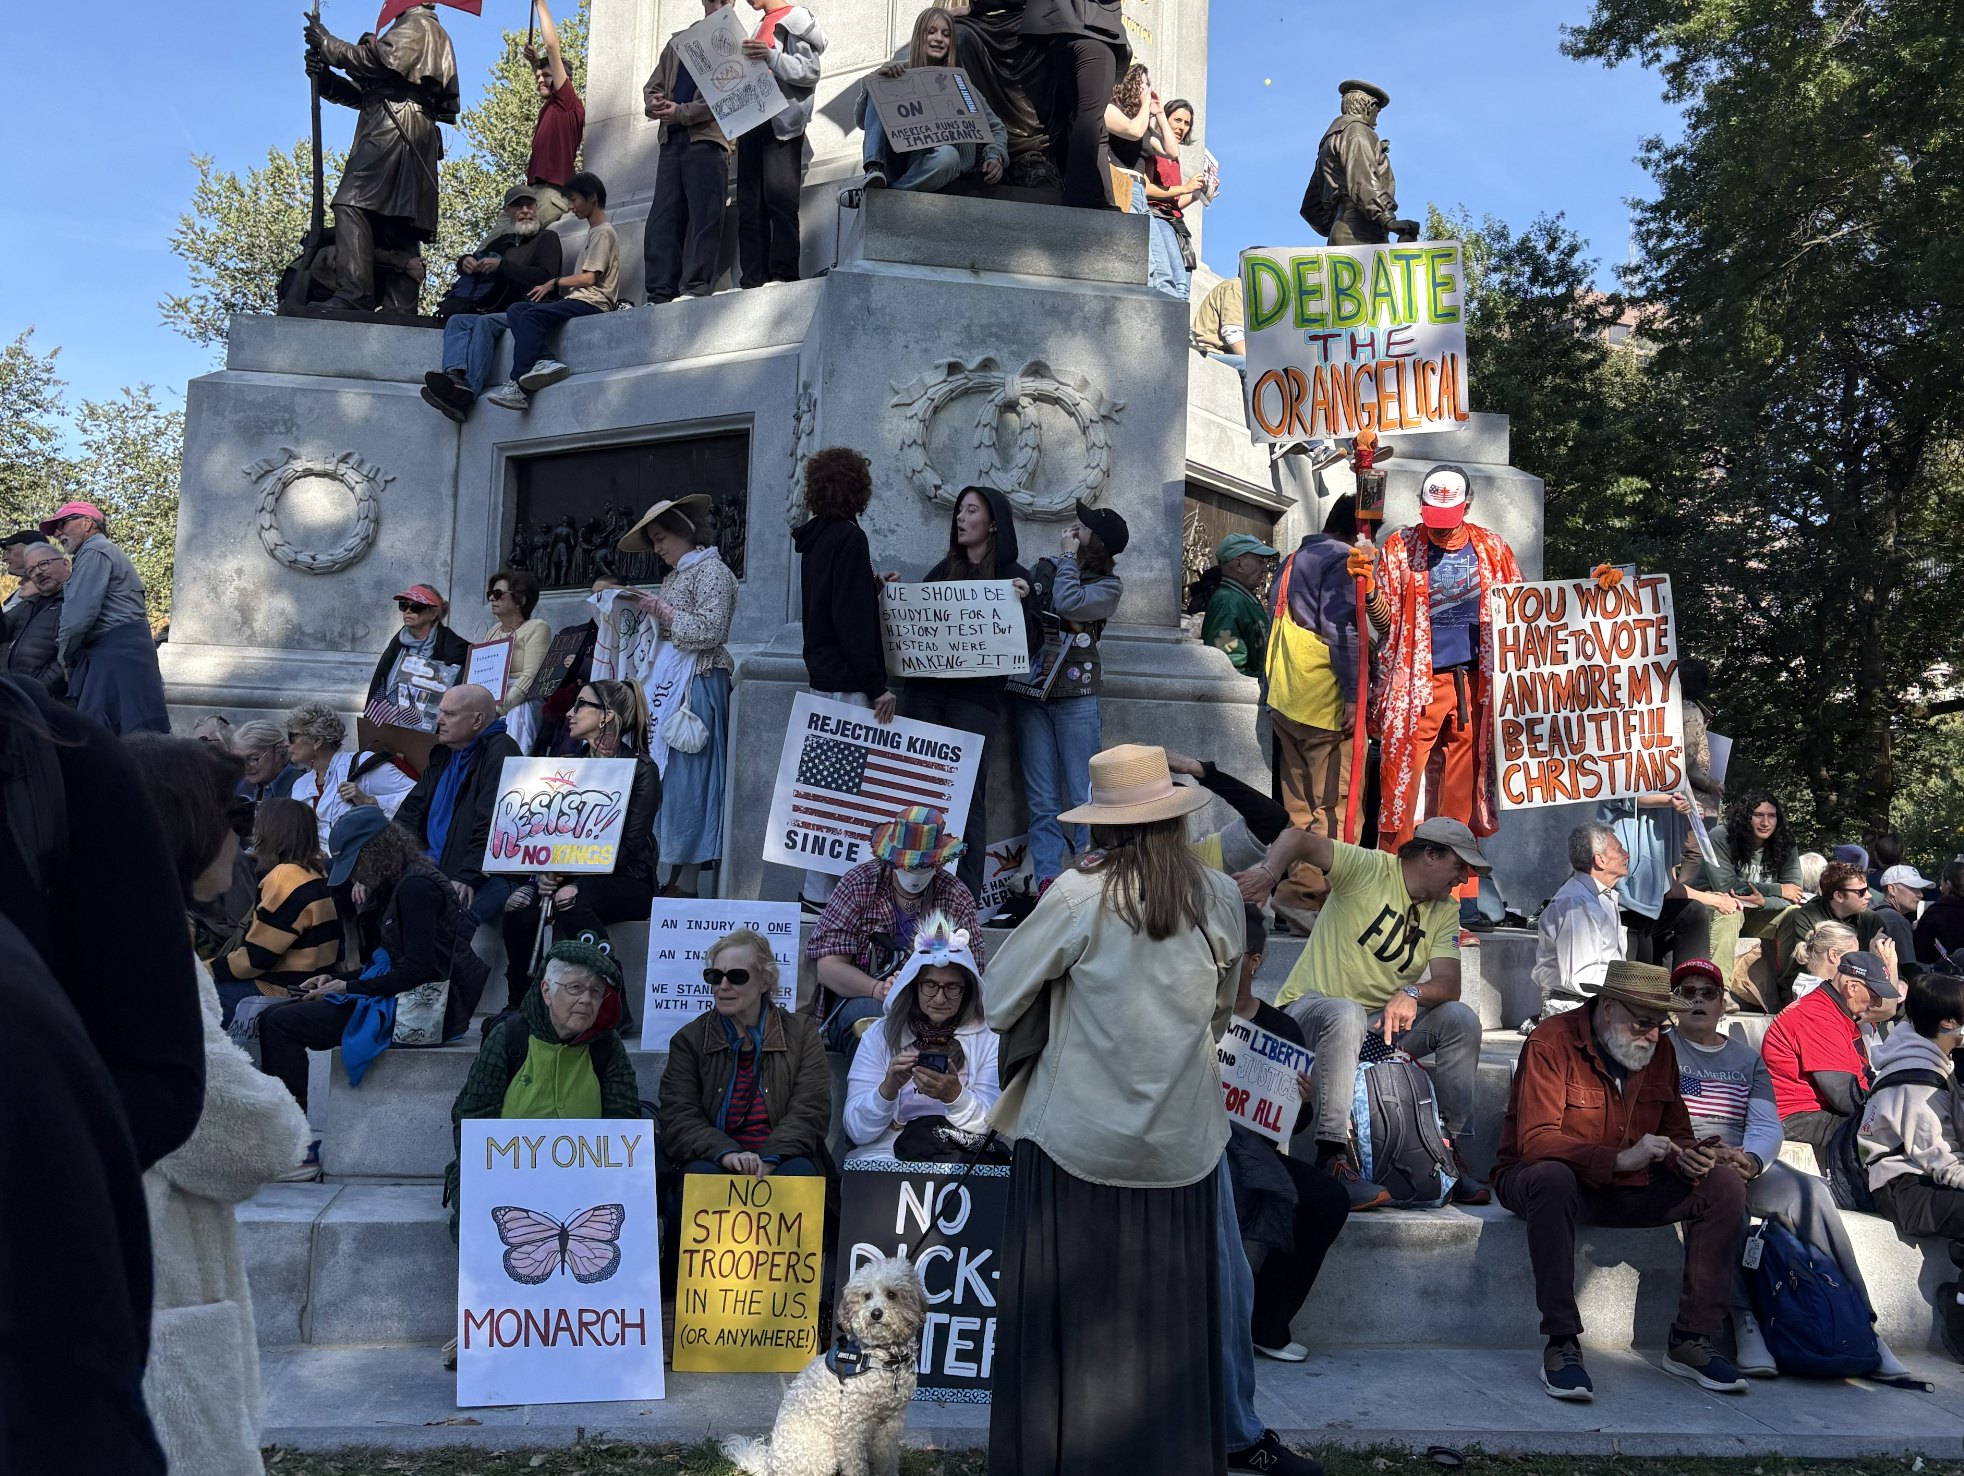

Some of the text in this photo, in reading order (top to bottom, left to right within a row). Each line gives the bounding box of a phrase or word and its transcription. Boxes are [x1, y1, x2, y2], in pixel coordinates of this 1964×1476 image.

[896, 100, 924, 118] ON
[891, 120, 976, 140] AMERICA RUNS ON
[903, 129, 984, 148] IMMIGRANTS
[1243, 247, 1460, 332] DEBATE
[1304, 324, 1419, 367] THE
[1252, 351, 1469, 438] ORANGELICAL
[886, 586, 1007, 601] WE SHOULD BE
[882, 607, 1002, 622] STUDYING FOR A
[885, 624, 939, 638] HISTORY
[945, 624, 988, 636] TEST
[887, 640, 988, 651] INSTEAD WE'RE
[1498, 616, 1669, 673] HAVE TO VOTE
[901, 654, 967, 671] MAKING
[976, 654, 1008, 666] IT
[1499, 659, 1678, 718] ANYMORE, MY
[807, 712, 962, 763] REJECTING KINGS
[1501, 707, 1673, 761] BEAUTIFUL
[521, 844, 614, 865] NO KINGS
[784, 829, 860, 863] SINCE
[661, 919, 792, 933] AN INJURY TO ONE
[1357, 903, 1426, 974] FDT
[658, 949, 676, 960] AN
[652, 984, 668, 994] WE
[655, 1000, 688, 1010] WITH
[1249, 1029, 1315, 1077] LIBERTY
[1236, 1053, 1299, 1103] JUSTICE
[1678, 1064, 1747, 1082] RO-AMERICA
[1251, 1098, 1283, 1133] ALL
[486, 1134, 642, 1170] MY ONLY
[727, 1178, 772, 1208] NO
[895, 1180, 972, 1235] NO
[692, 1209, 803, 1248] STORM
[682, 1249, 817, 1284] TROOPERS
[685, 1288, 808, 1320] IN THE U.S.
[463, 1307, 646, 1350] MONARCH
[680, 1323, 816, 1354] (OR ANYWHERE!)
